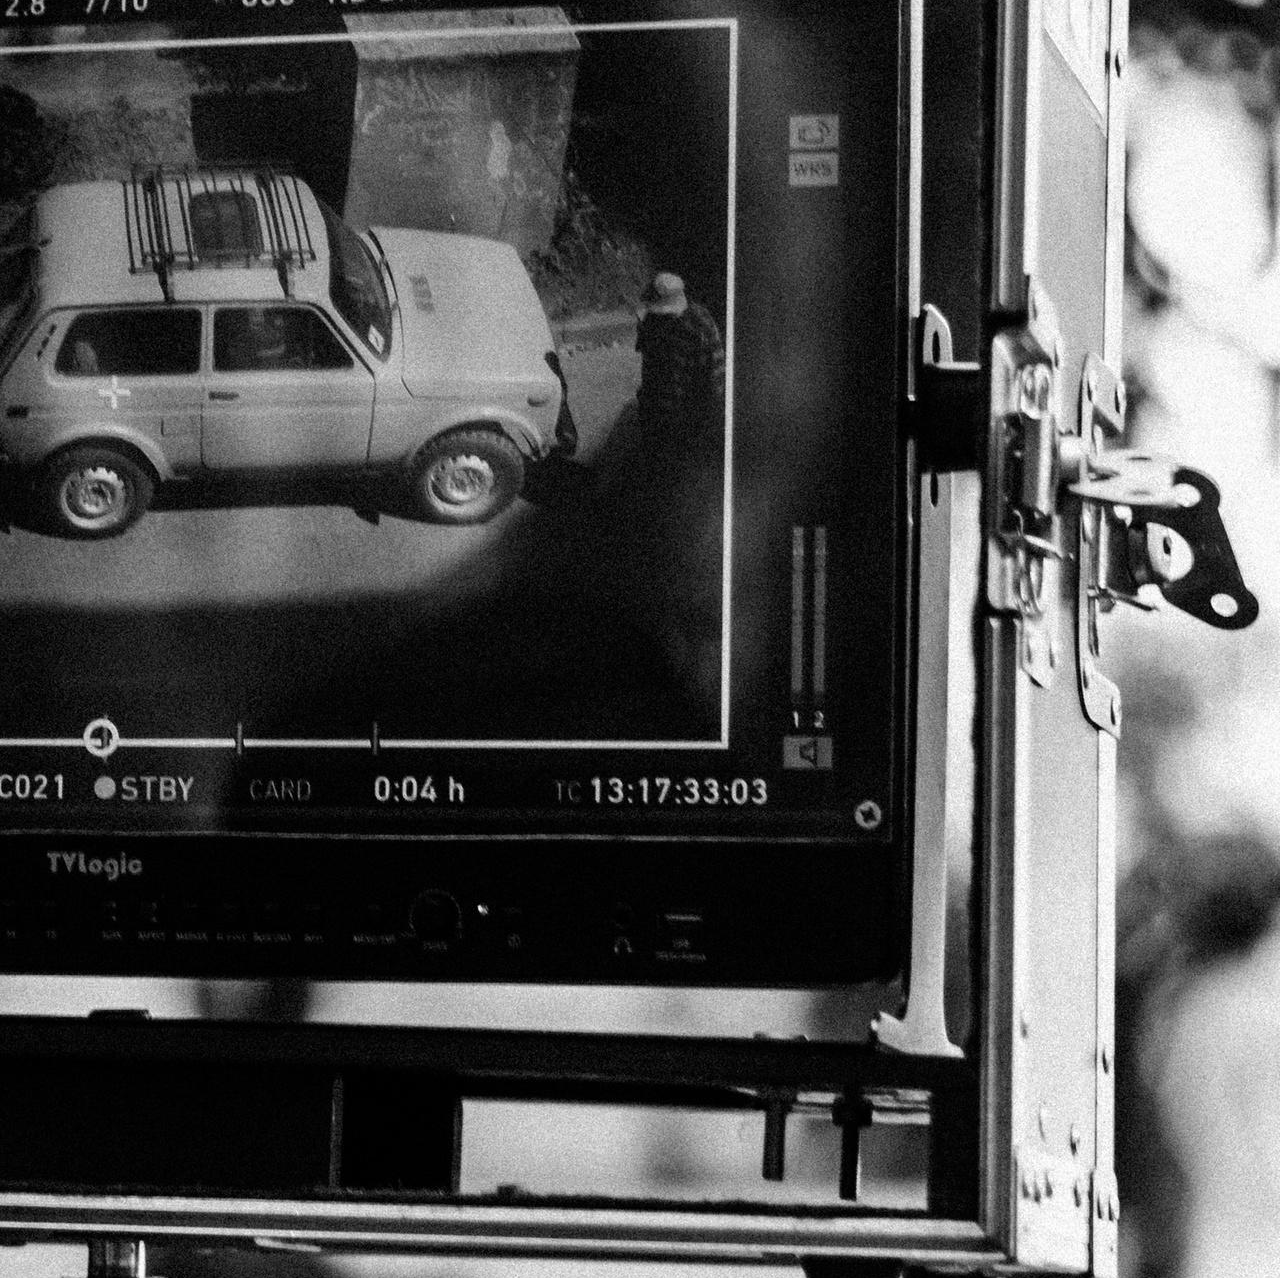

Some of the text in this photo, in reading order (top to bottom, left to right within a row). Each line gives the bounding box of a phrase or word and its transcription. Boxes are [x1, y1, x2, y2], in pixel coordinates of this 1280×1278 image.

[120, 775, 195, 803] STBY
[249, 774, 466, 803] CARD 0:04 h
[556, 776, 768, 805] TC 13:17:33:03
[46, 850, 143, 882] TVlogic
